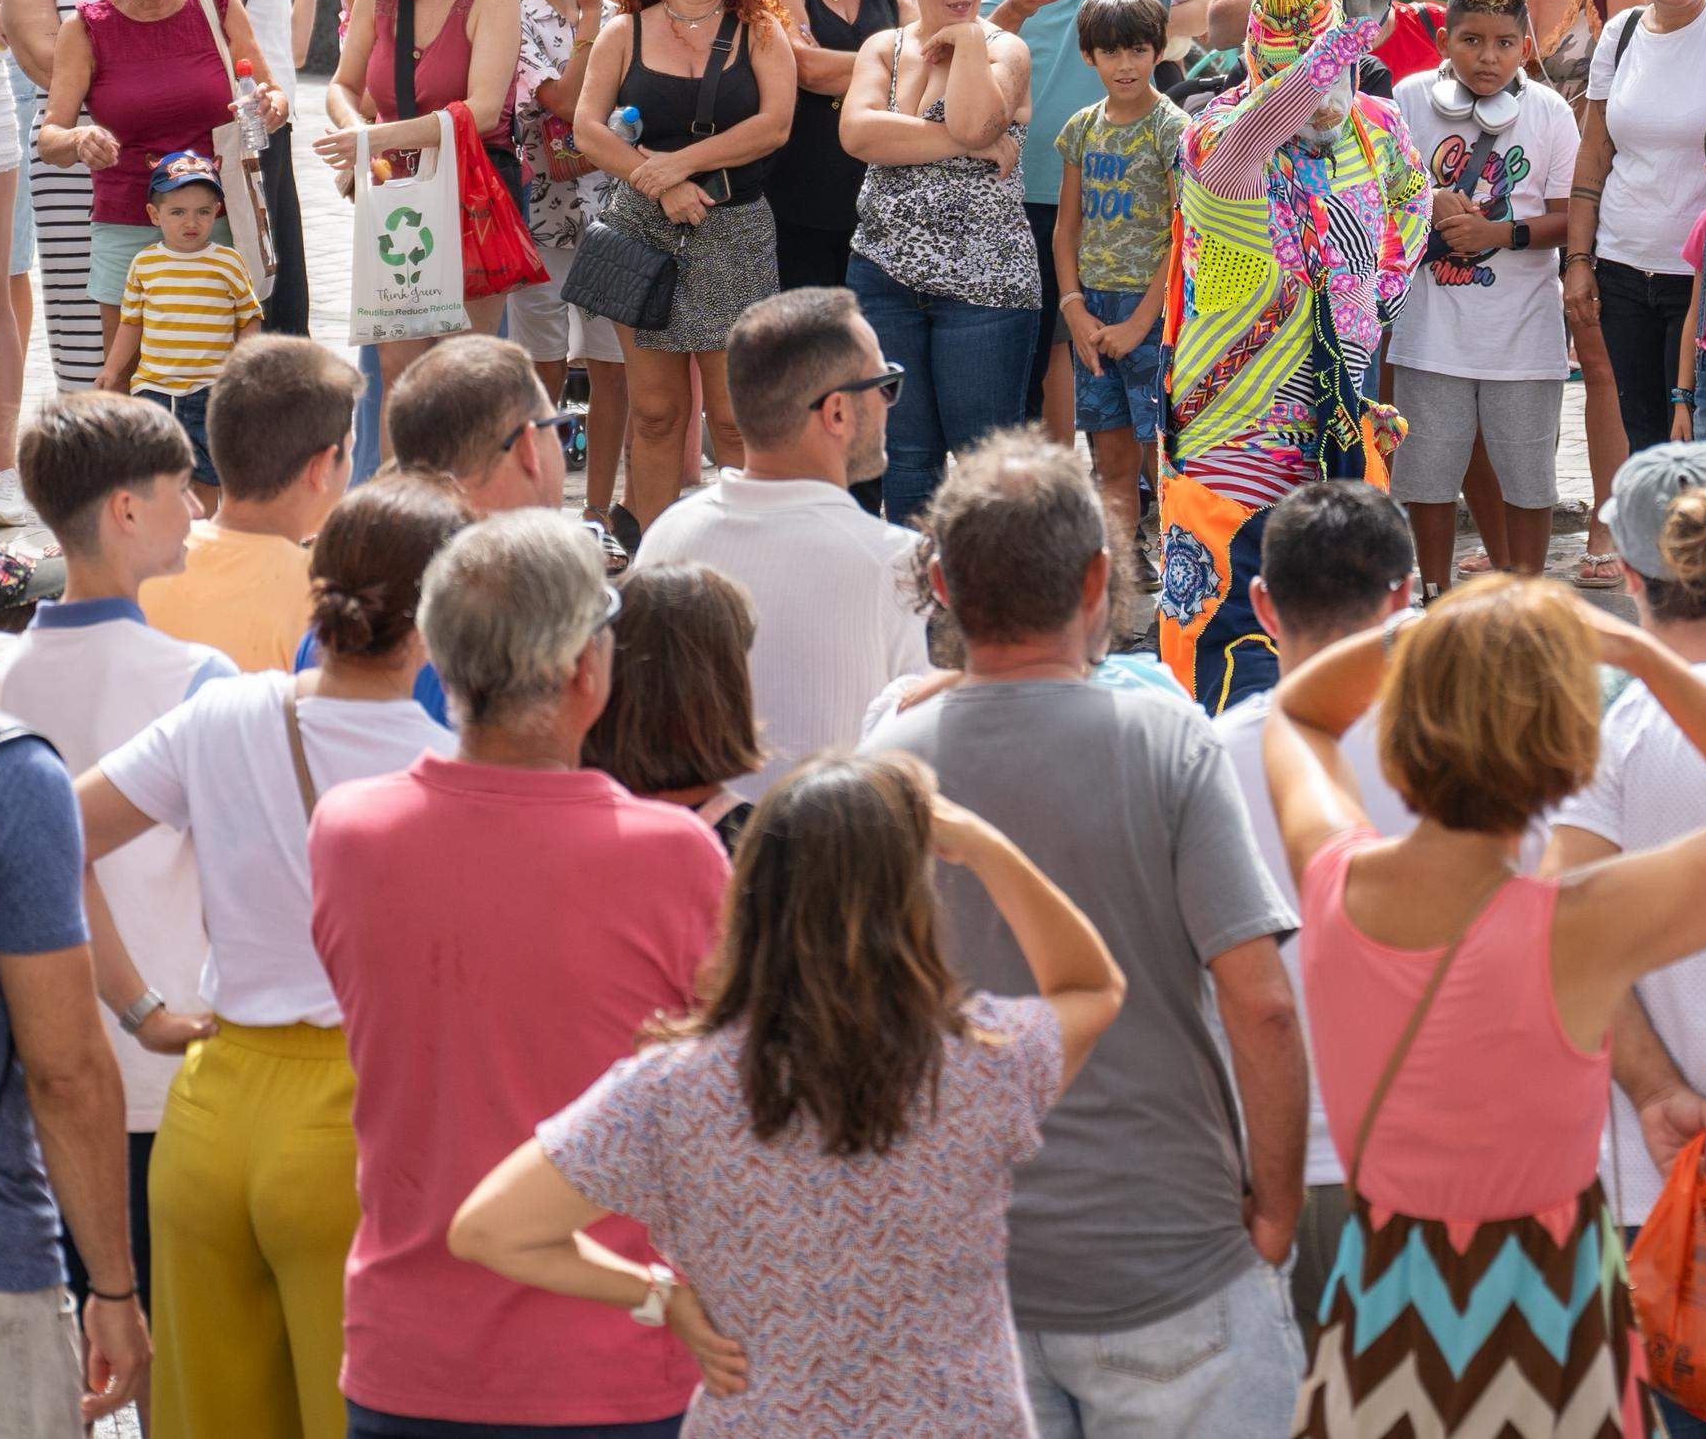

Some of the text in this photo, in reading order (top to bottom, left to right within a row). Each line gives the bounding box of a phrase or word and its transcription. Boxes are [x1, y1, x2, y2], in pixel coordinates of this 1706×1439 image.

[1083, 151, 1135, 180] STAY
[376, 289, 409, 302] Think
[357, 302, 462, 318] Reutiliza Reduce Recicla
